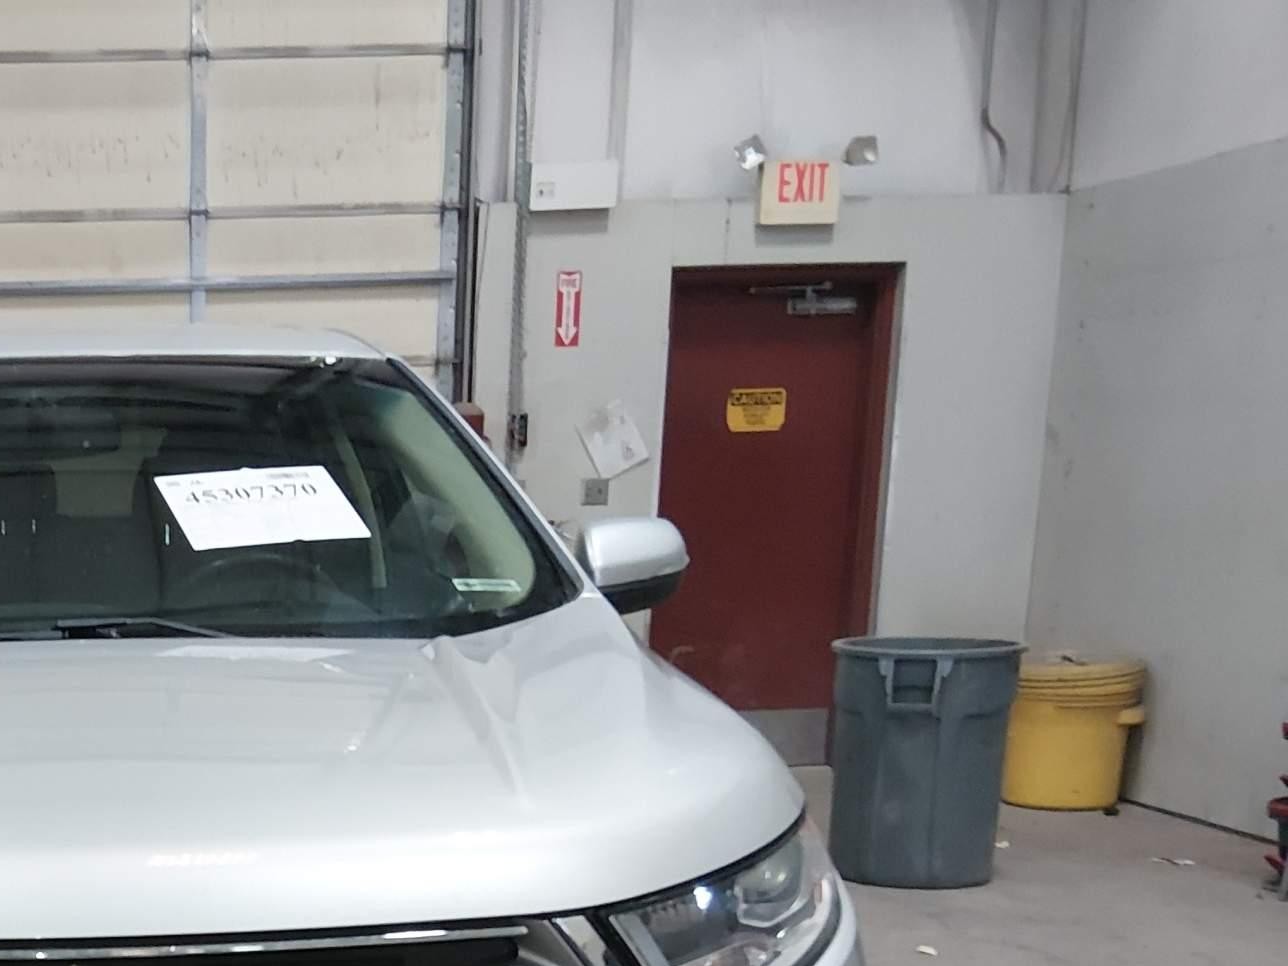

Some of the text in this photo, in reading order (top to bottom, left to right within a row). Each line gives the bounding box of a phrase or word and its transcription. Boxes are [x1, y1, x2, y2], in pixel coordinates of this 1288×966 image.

[778, 162, 830, 203] EXIT
[731, 392, 783, 406] CAUTION
[185, 483, 318, 504] 45307370
